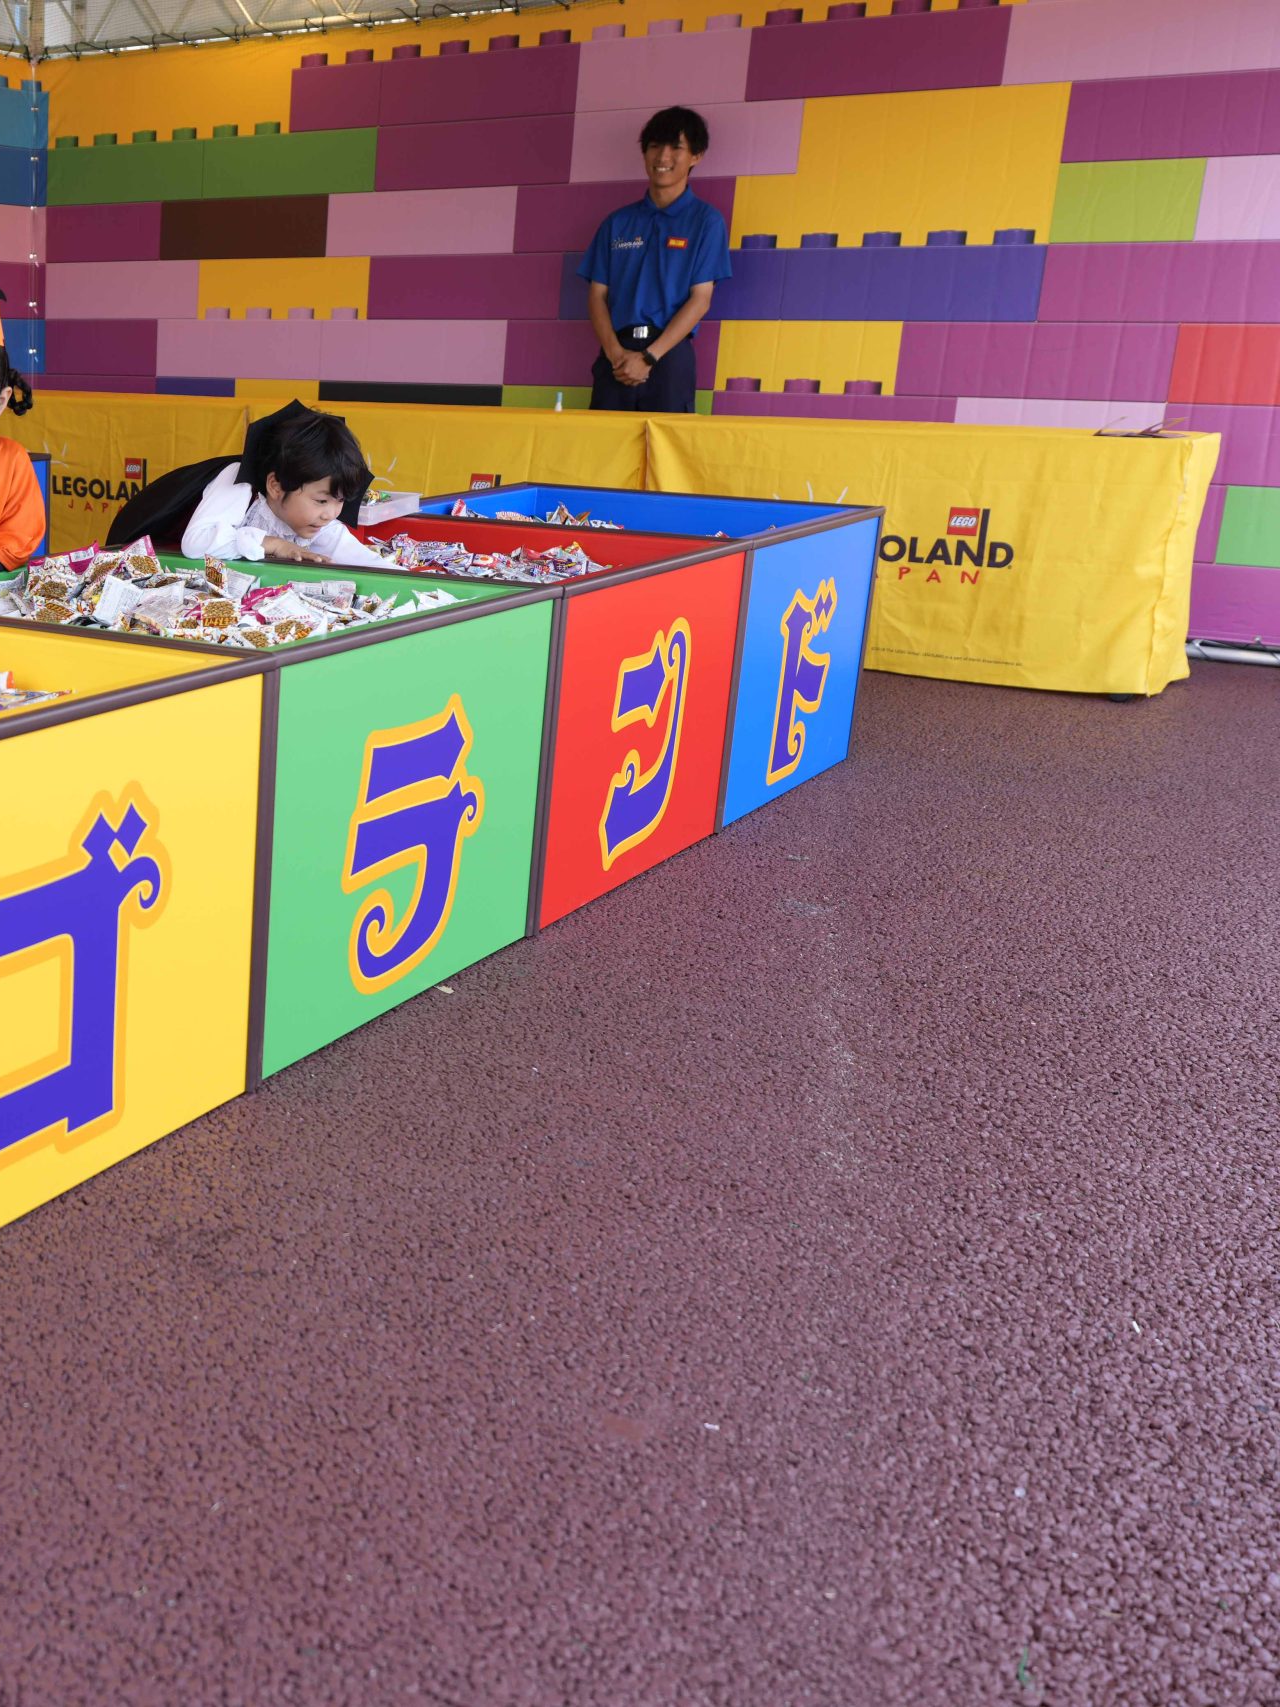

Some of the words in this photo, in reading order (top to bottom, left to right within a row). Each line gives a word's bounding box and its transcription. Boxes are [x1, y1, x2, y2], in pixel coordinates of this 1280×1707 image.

[949, 514, 978, 528] LEGO
[875, 566, 981, 585] PAN
[341, 693, 486, 995] ラ
[766, 577, 838, 787] ド
